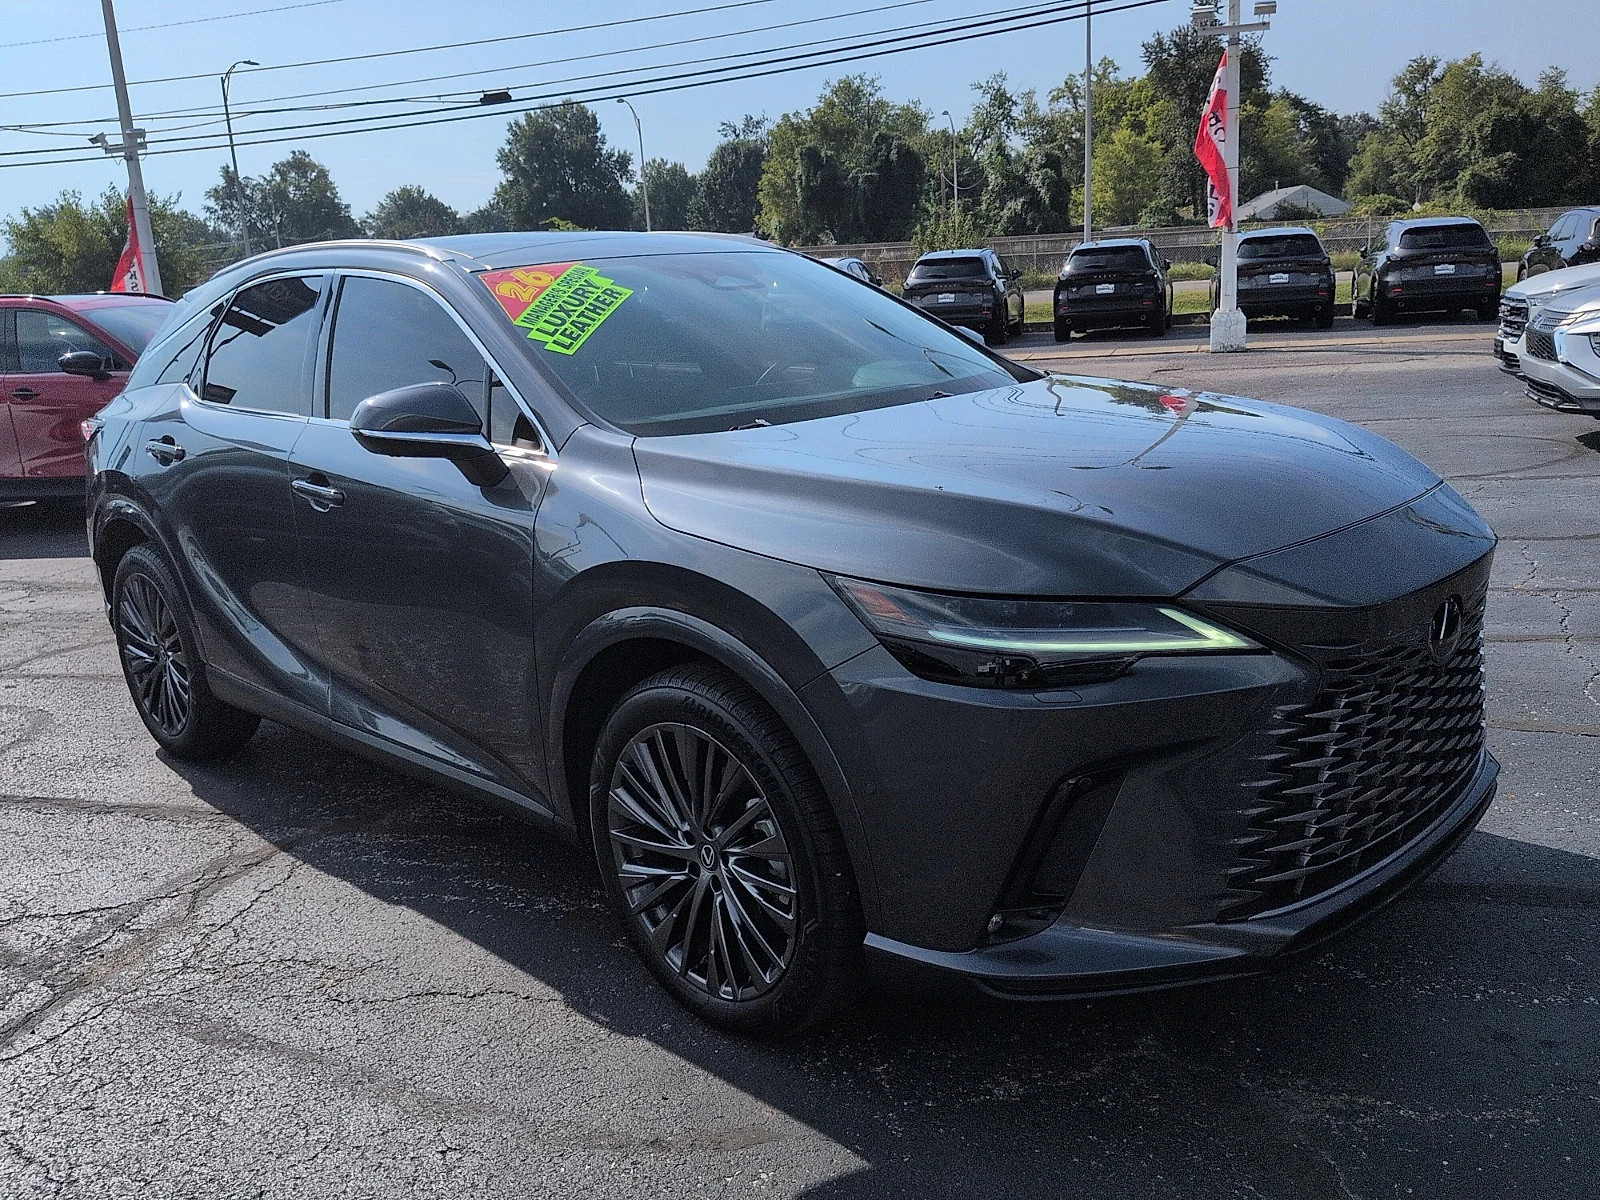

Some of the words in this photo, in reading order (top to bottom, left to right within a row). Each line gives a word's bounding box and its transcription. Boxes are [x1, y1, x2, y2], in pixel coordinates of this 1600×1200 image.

[496, 269, 555, 303] 26
[521, 287, 567, 326] MANAGER'S
[557, 267, 591, 293] SPECIAL
[535, 278, 601, 338] LUXURY
[552, 286, 625, 351] LEATHER
